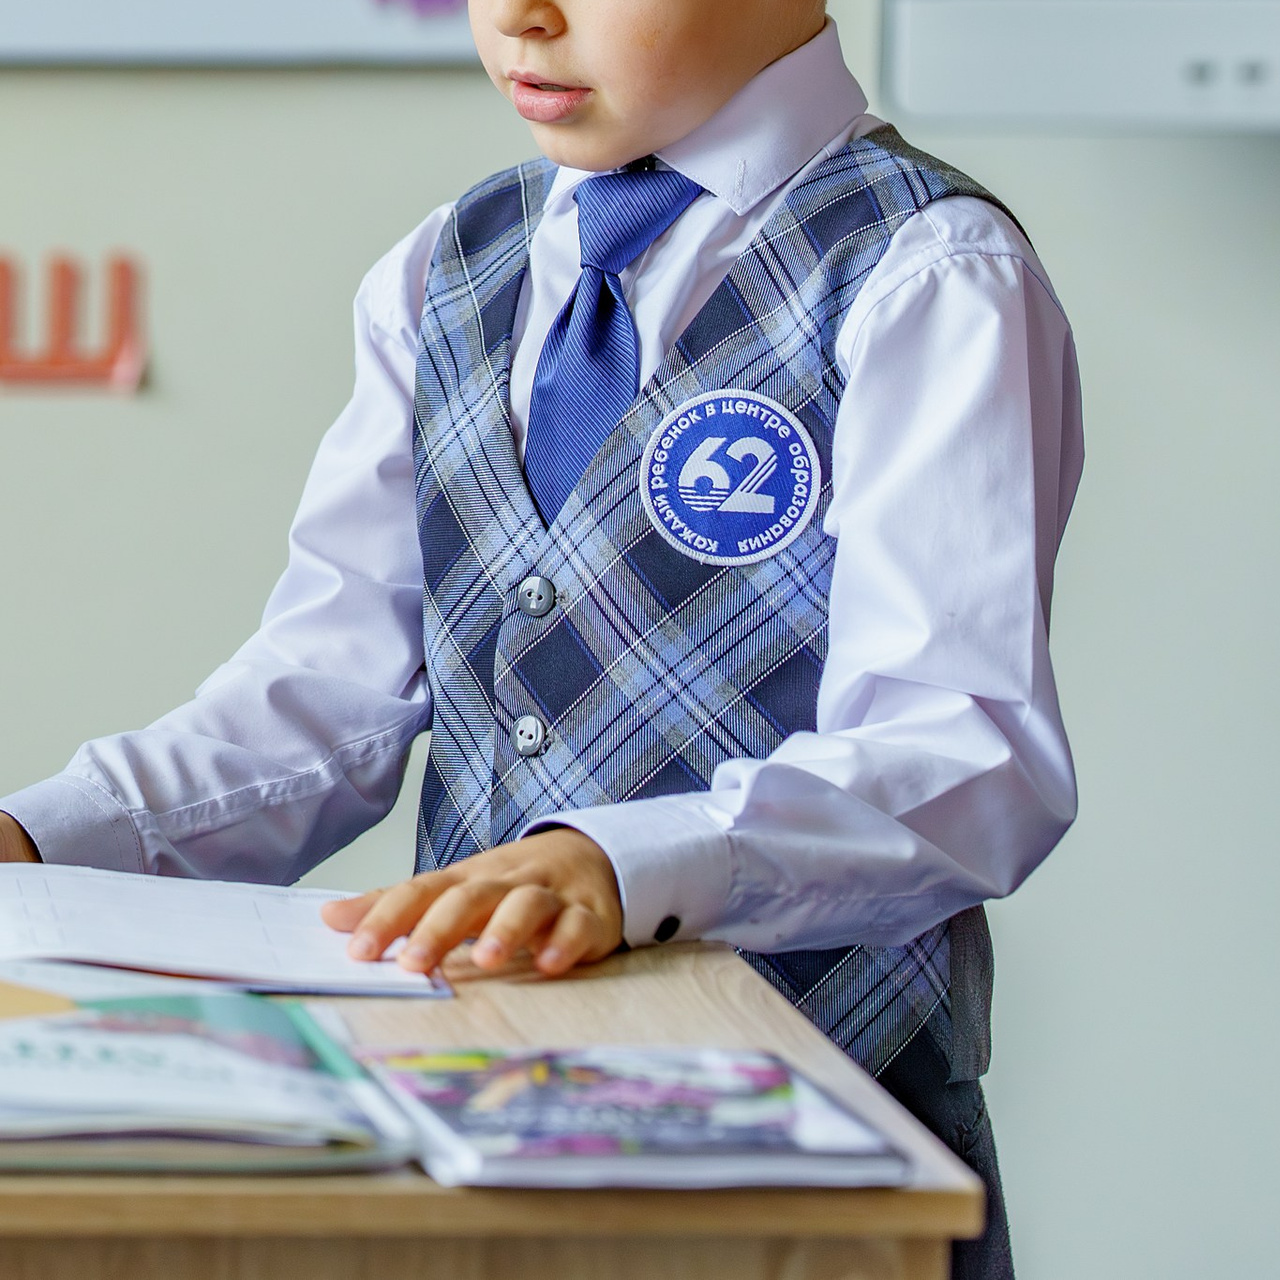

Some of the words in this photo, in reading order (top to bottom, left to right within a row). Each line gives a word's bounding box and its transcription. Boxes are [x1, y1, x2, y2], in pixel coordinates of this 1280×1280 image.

[705, 404, 717, 416] в
[721, 400, 791, 439] центре
[651, 409, 702, 490] ребенок
[677, 436, 778, 514] 62
[653, 495, 719, 553] каждый
[737, 442, 810, 554] образования
